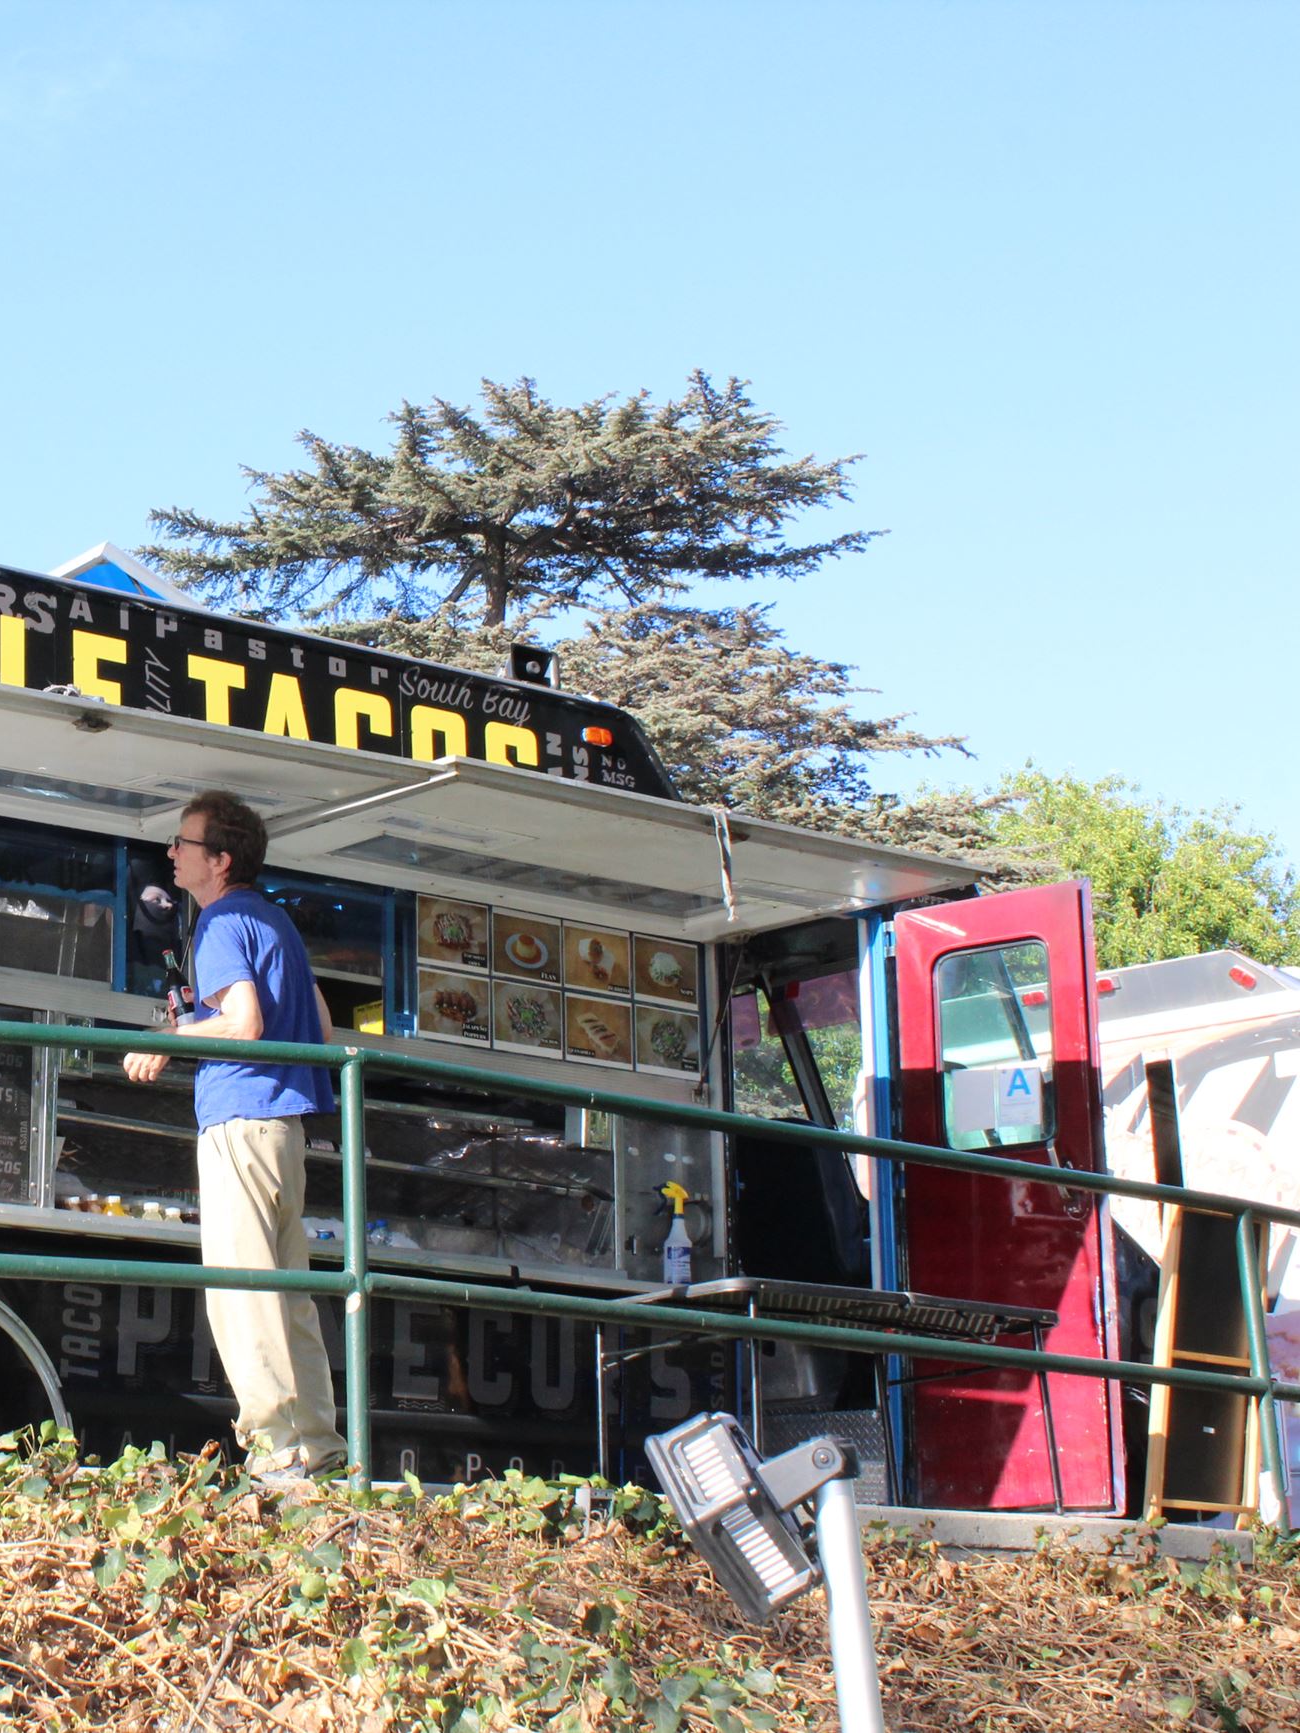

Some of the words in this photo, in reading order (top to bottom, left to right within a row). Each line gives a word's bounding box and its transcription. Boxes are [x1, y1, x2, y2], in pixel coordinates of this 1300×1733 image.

[399, 665, 474, 710] South
[482, 690, 531, 727] Bay
[602, 769, 636, 788] MSG
[540, 971, 557, 981] FLAN
[1007, 1067, 1032, 1097] A
